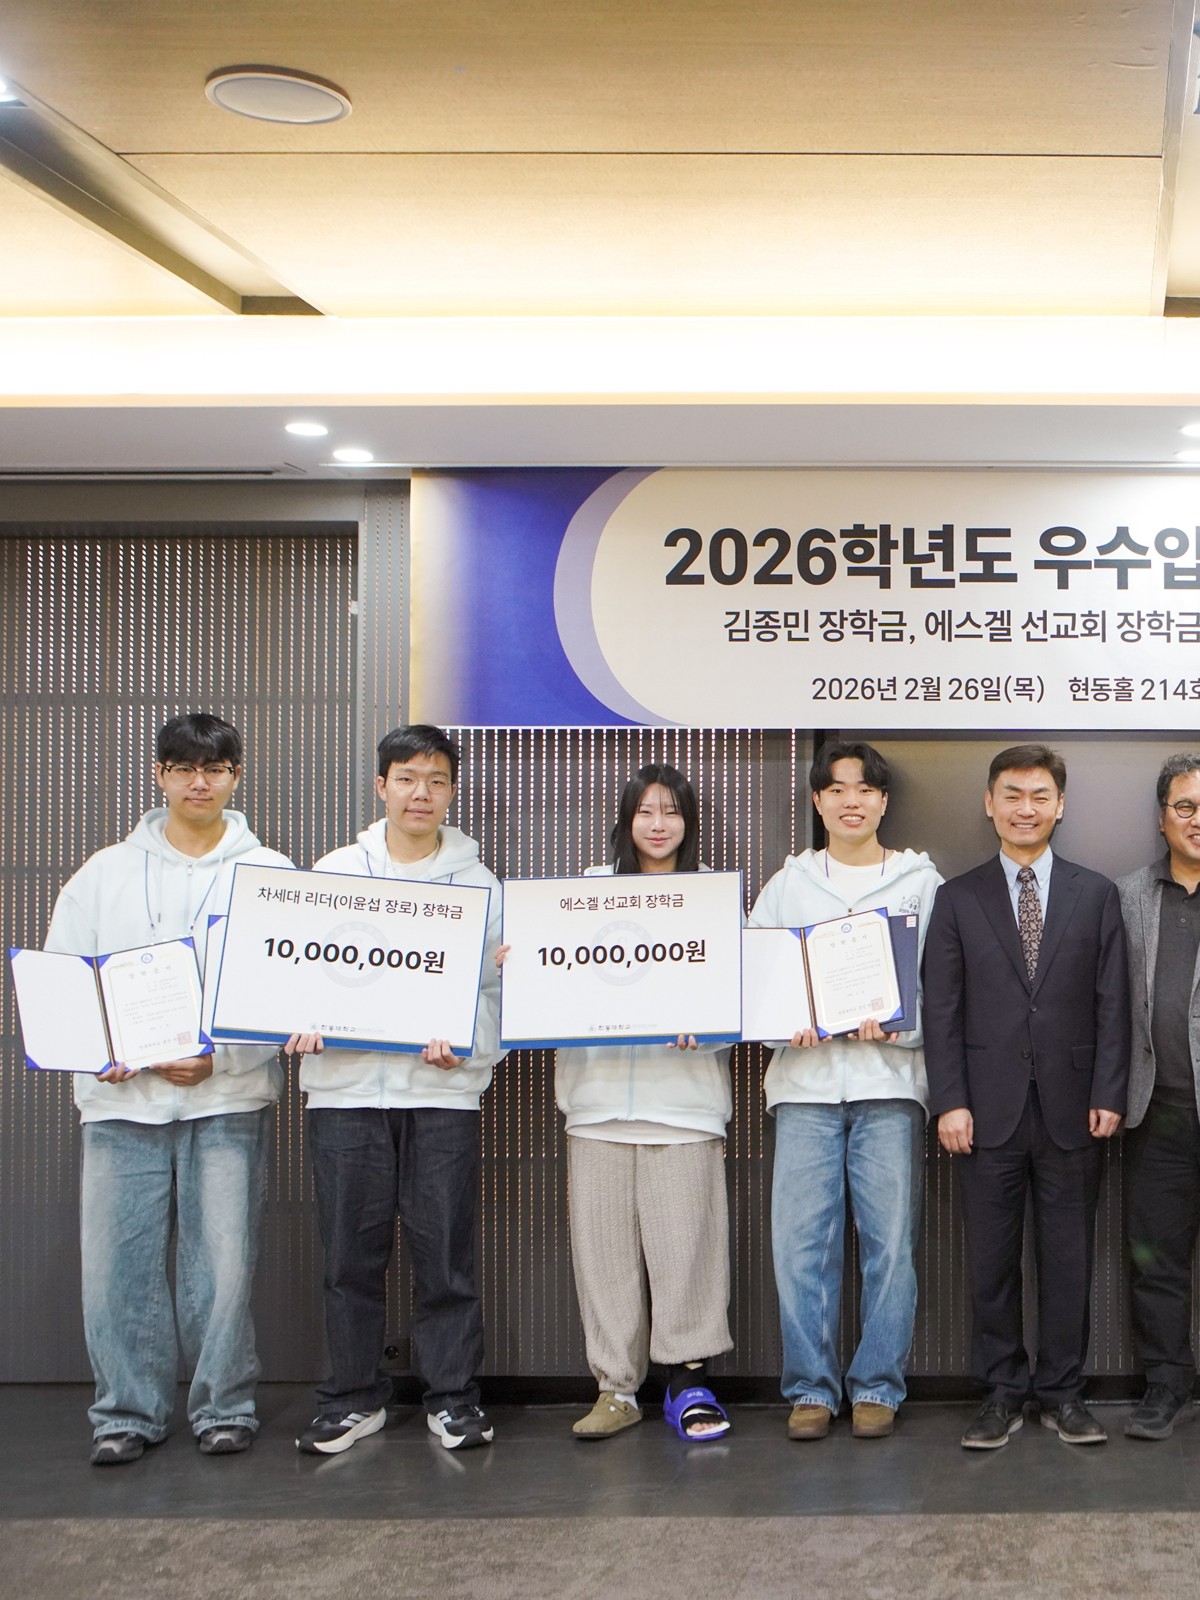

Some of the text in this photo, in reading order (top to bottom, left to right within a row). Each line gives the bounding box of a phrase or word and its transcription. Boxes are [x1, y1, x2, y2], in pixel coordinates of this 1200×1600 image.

[664, 524, 1017, 589] 2026학년도
[724, 609, 809, 642] 김종민
[819, 609, 915, 644] 장학금,
[925, 610, 1012, 642] 에스겔
[1021, 610, 1106, 642] 선교회
[812, 676, 897, 701] 2026년
[905, 677, 941, 701] 2월
[949, 675, 1044, 703] 26일(목)
[1069, 677, 1134, 701] 현동홀
[258, 887, 463, 919] 차세대 리더(이윤섭 장로) 장학금
[560, 894, 684, 911] 에스겔 선교회 장학금
[265, 938, 445, 974] 10,000,000원
[538, 940, 706, 970] 10,000,000원
